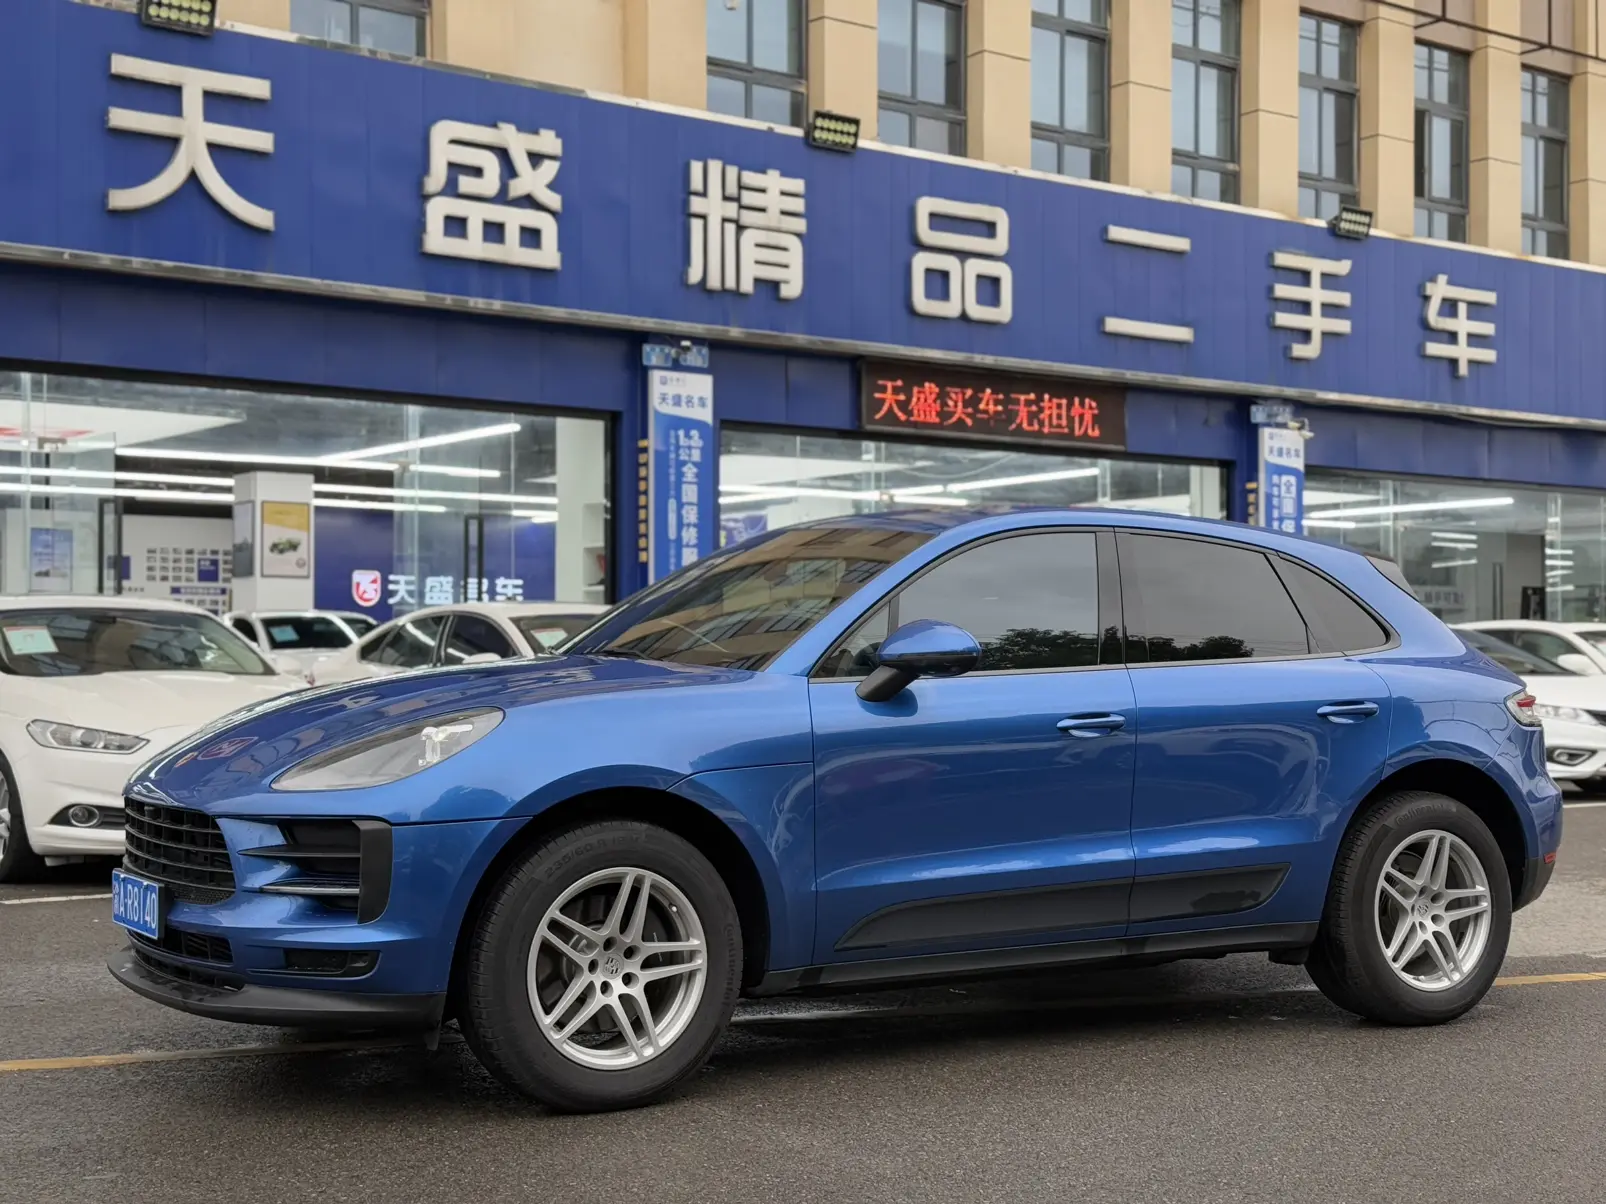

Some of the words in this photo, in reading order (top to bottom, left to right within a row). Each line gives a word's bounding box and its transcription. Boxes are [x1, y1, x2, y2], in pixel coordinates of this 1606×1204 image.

[105, 53, 1497, 378] 天盛精品二手车
[873, 379, 1101, 438] 天盛买车无担忧
